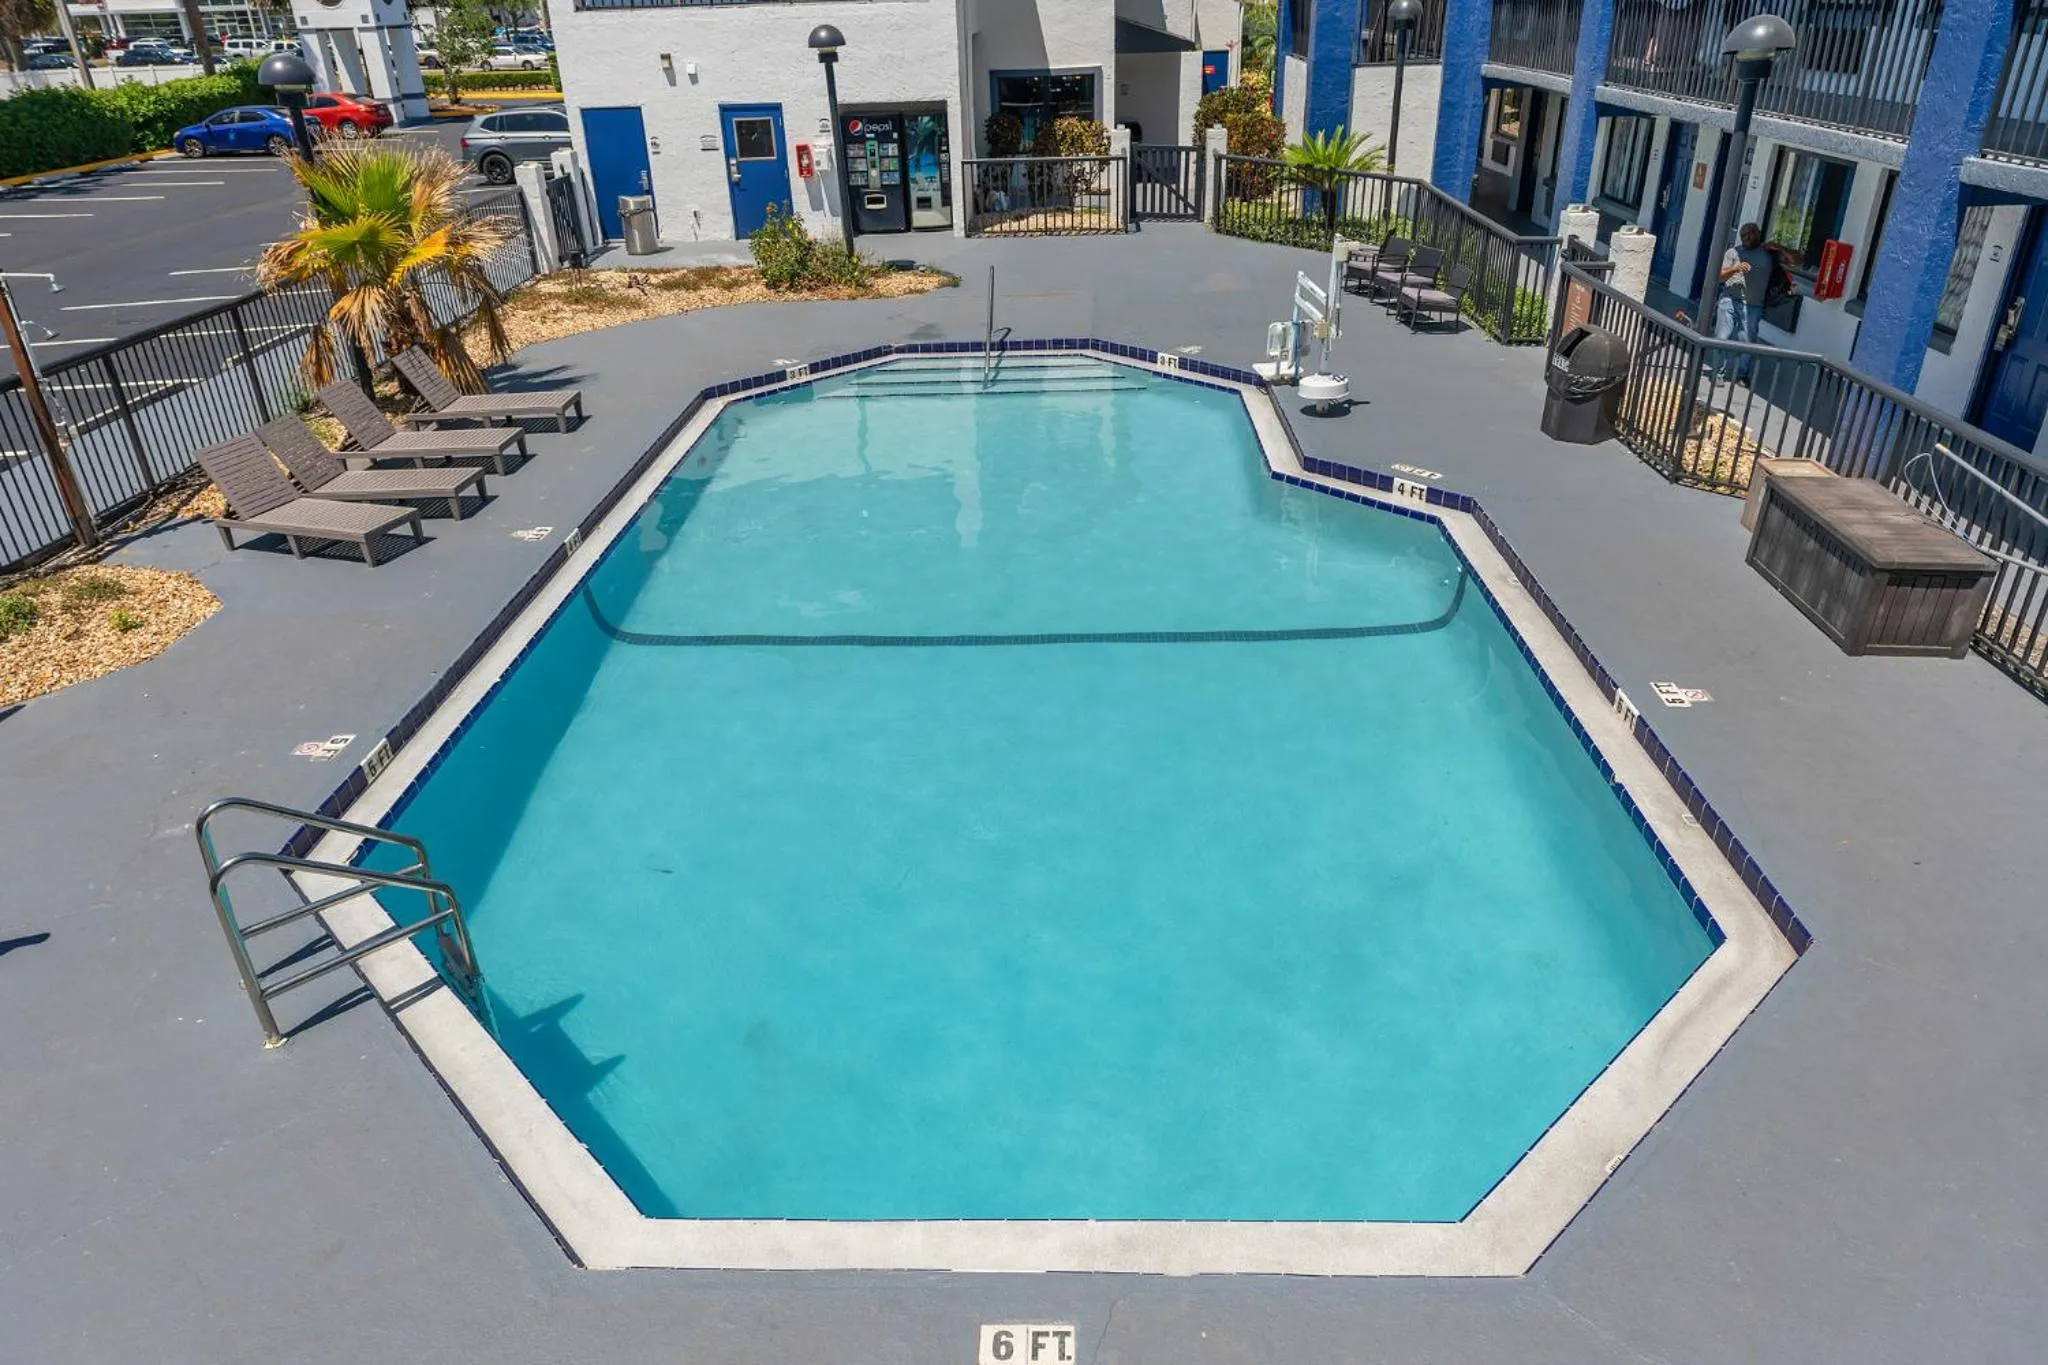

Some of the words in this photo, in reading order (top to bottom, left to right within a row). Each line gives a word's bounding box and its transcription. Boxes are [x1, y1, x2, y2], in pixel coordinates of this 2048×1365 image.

[864, 120, 892, 133] pepsi
[1397, 482, 1405, 495] 4
[1410, 485, 1425, 500] FT
[1654, 683, 1679, 695] FT
[992, 1330, 1014, 1361] 6
[1031, 1330, 1072, 1361] FT.
